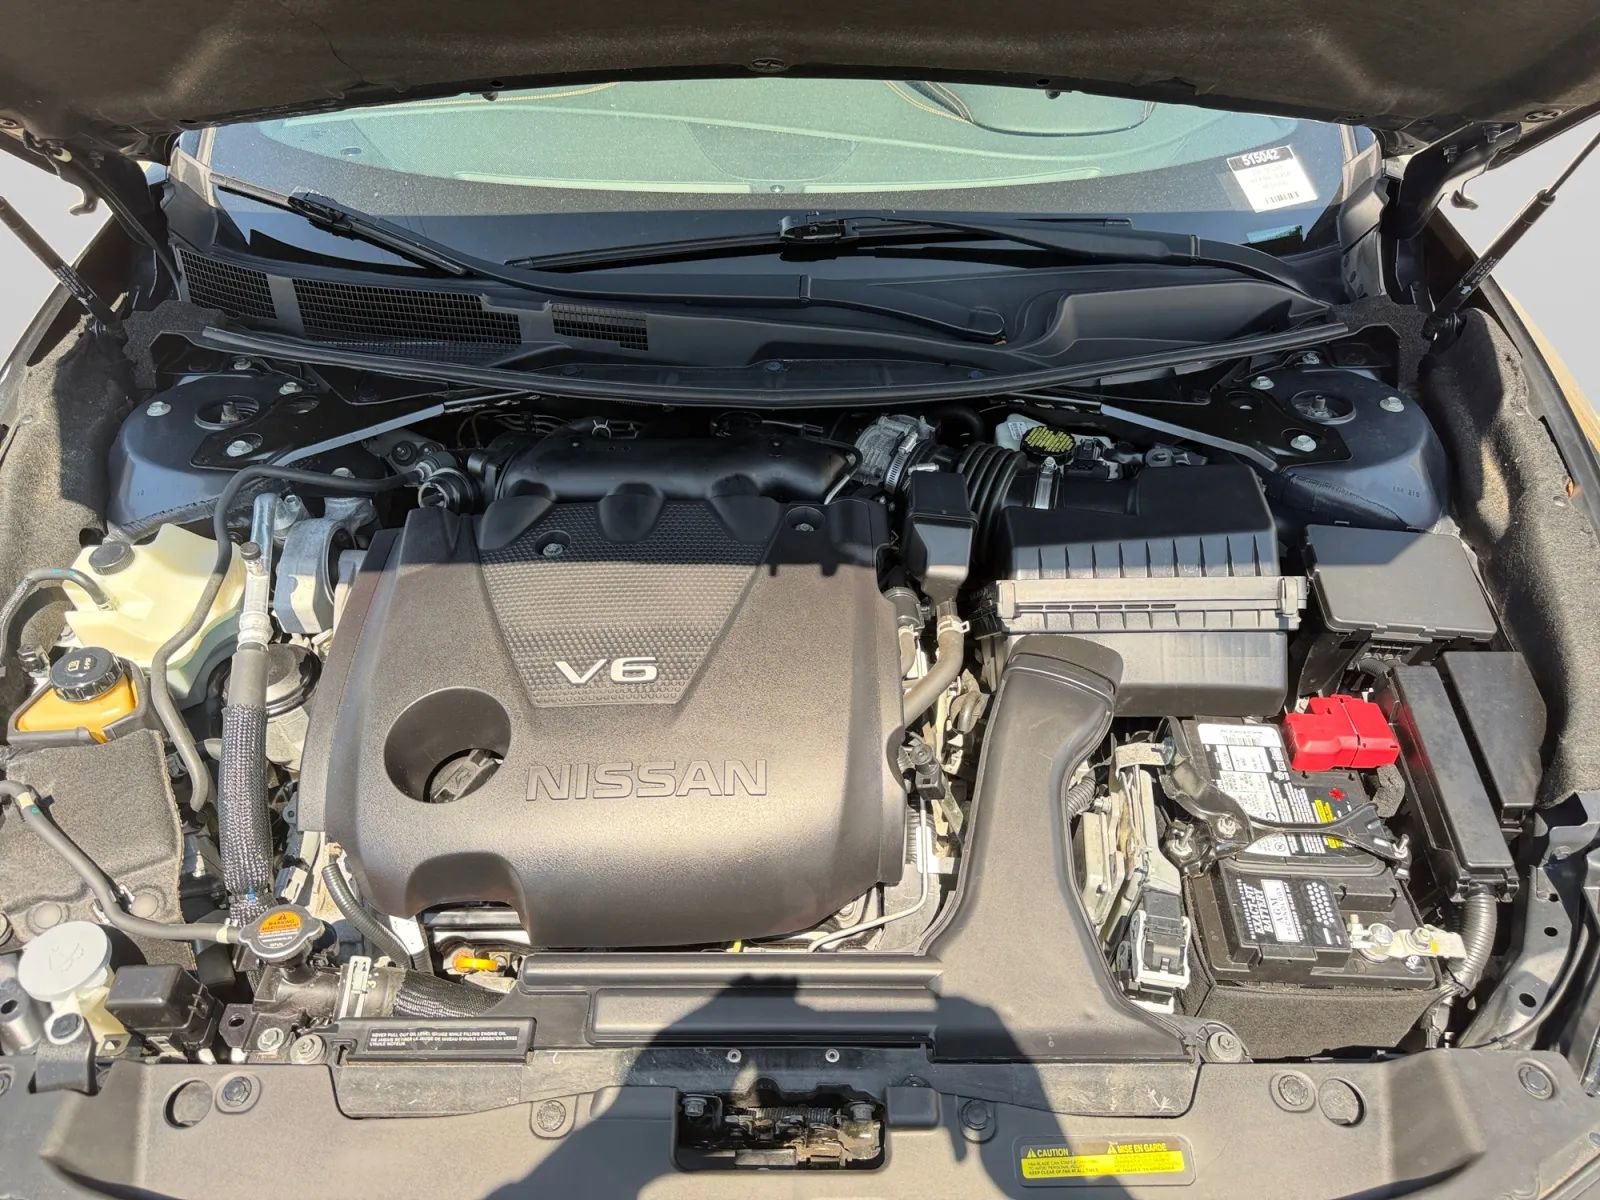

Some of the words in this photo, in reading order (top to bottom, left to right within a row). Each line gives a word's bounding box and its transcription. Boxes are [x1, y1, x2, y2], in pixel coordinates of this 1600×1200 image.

[1242, 149, 1280, 166] 515042
[555, 656, 658, 685] V6
[525, 759, 767, 801] NISSAN
[1243, 883, 1265, 935] EXACT-FIT
[1254, 888, 1274, 933] BATTERY
[1270, 898, 1283, 921] AGM
[1276, 888, 1292, 935] TECHNOLOGY
[1037, 1148, 1069, 1157] CAUTION
[1133, 1143, 1143, 1153] EN
[1144, 1142, 1167, 1152] GARDE
